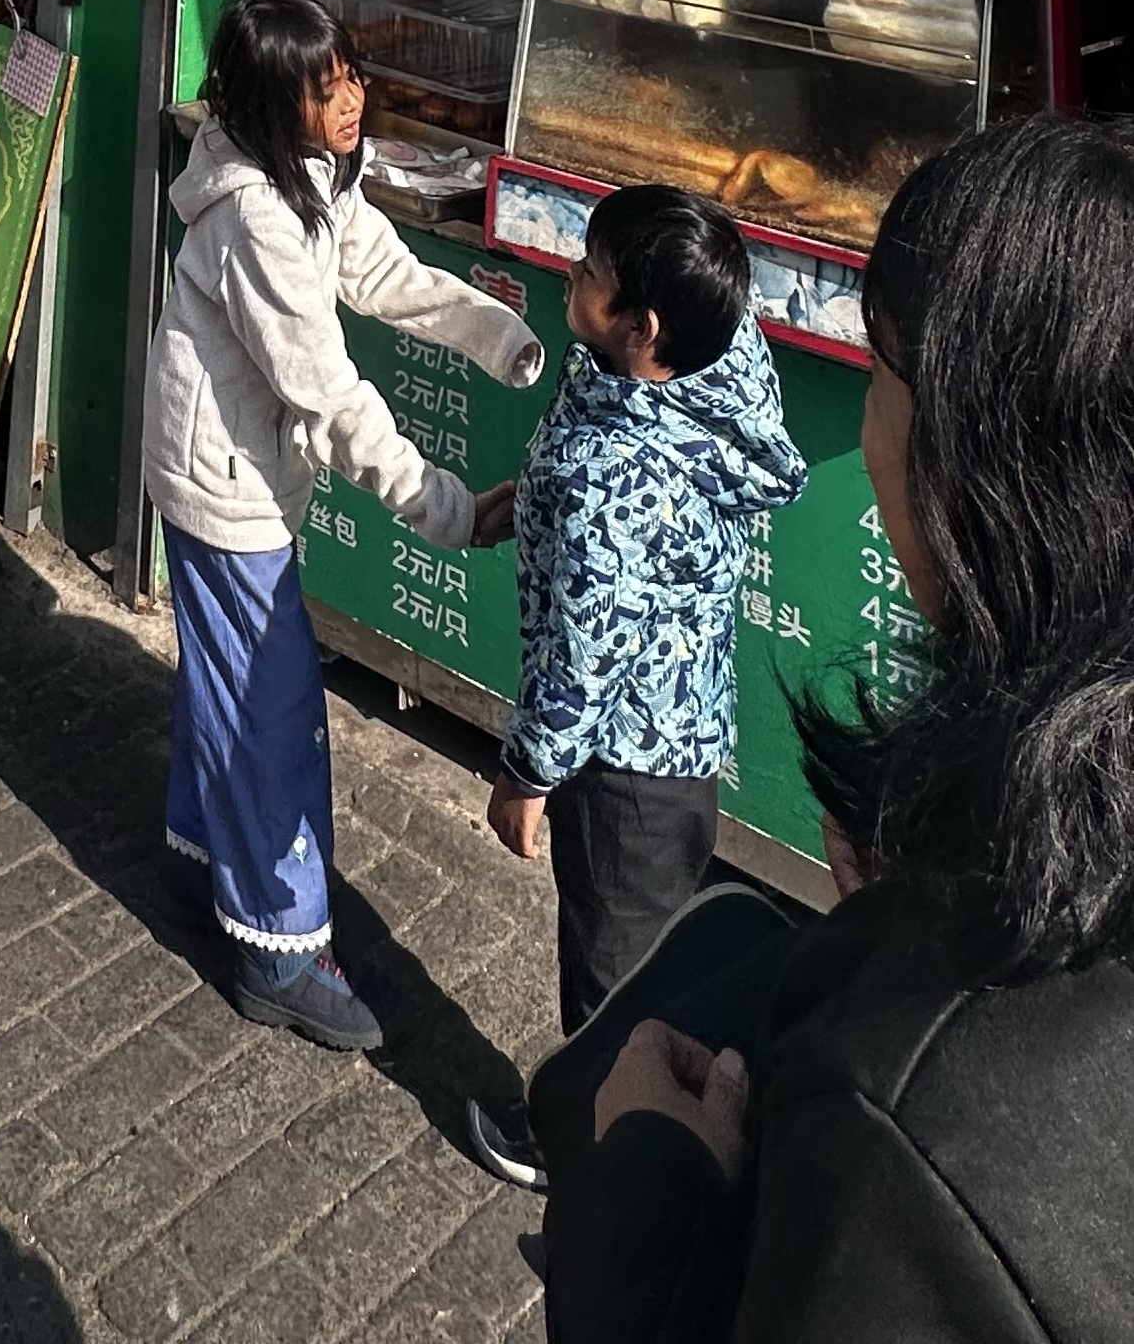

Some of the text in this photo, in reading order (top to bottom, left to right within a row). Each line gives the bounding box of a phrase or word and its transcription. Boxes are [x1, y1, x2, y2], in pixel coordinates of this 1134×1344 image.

[393, 371, 469, 425] 2元/只
[392, 539, 468, 603] 2元/只
[392, 583, 468, 647] 2元/只
